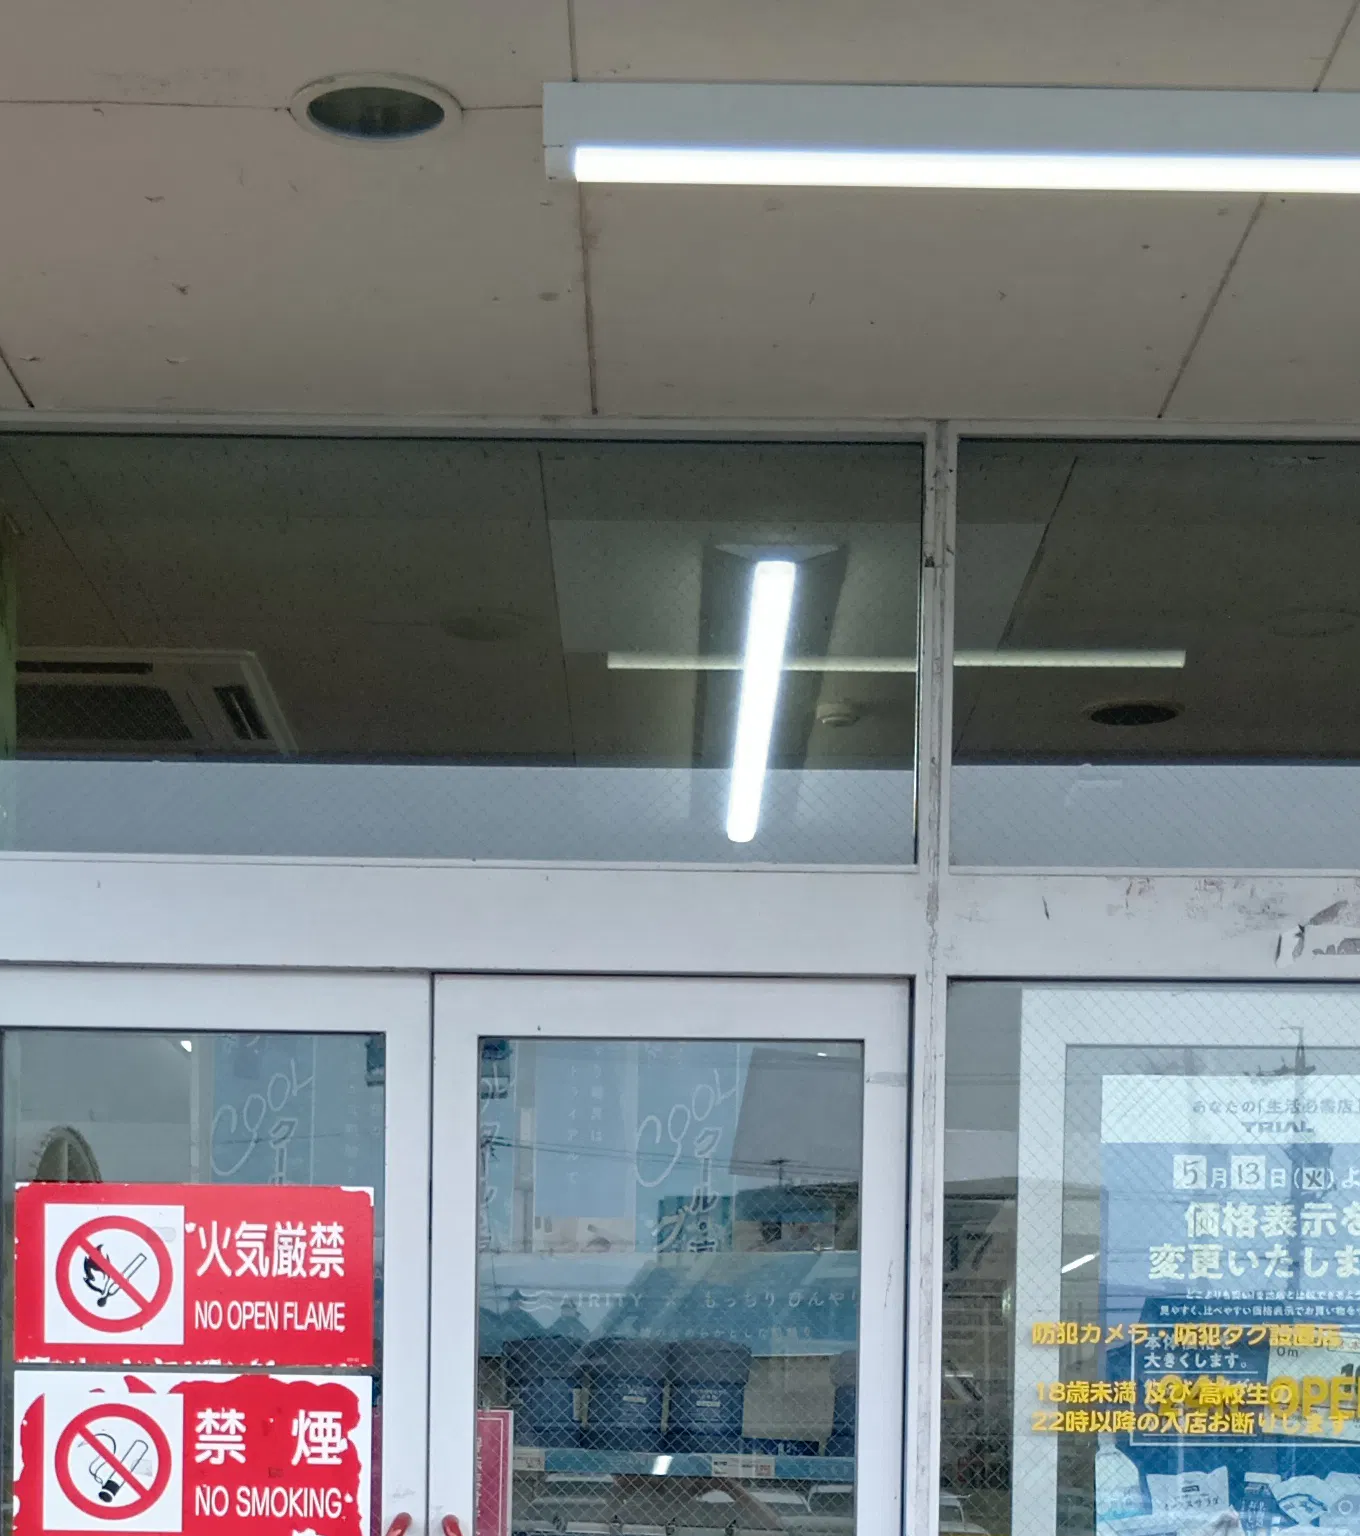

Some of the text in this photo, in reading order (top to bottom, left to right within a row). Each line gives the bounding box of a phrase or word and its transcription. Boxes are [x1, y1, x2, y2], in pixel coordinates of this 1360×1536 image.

[1240, 1121, 1315, 1134] TRIAL
[196, 1220, 345, 1279] 火気厳禁
[194, 1300, 346, 1332] NO OPEN FLAME
[1143, 1352, 1248, 1369] 大きくします。
[1030, 1410, 1350, 1435] 22時以降の入店お断りします
[194, 1485, 343, 1519] NO SMOKING
